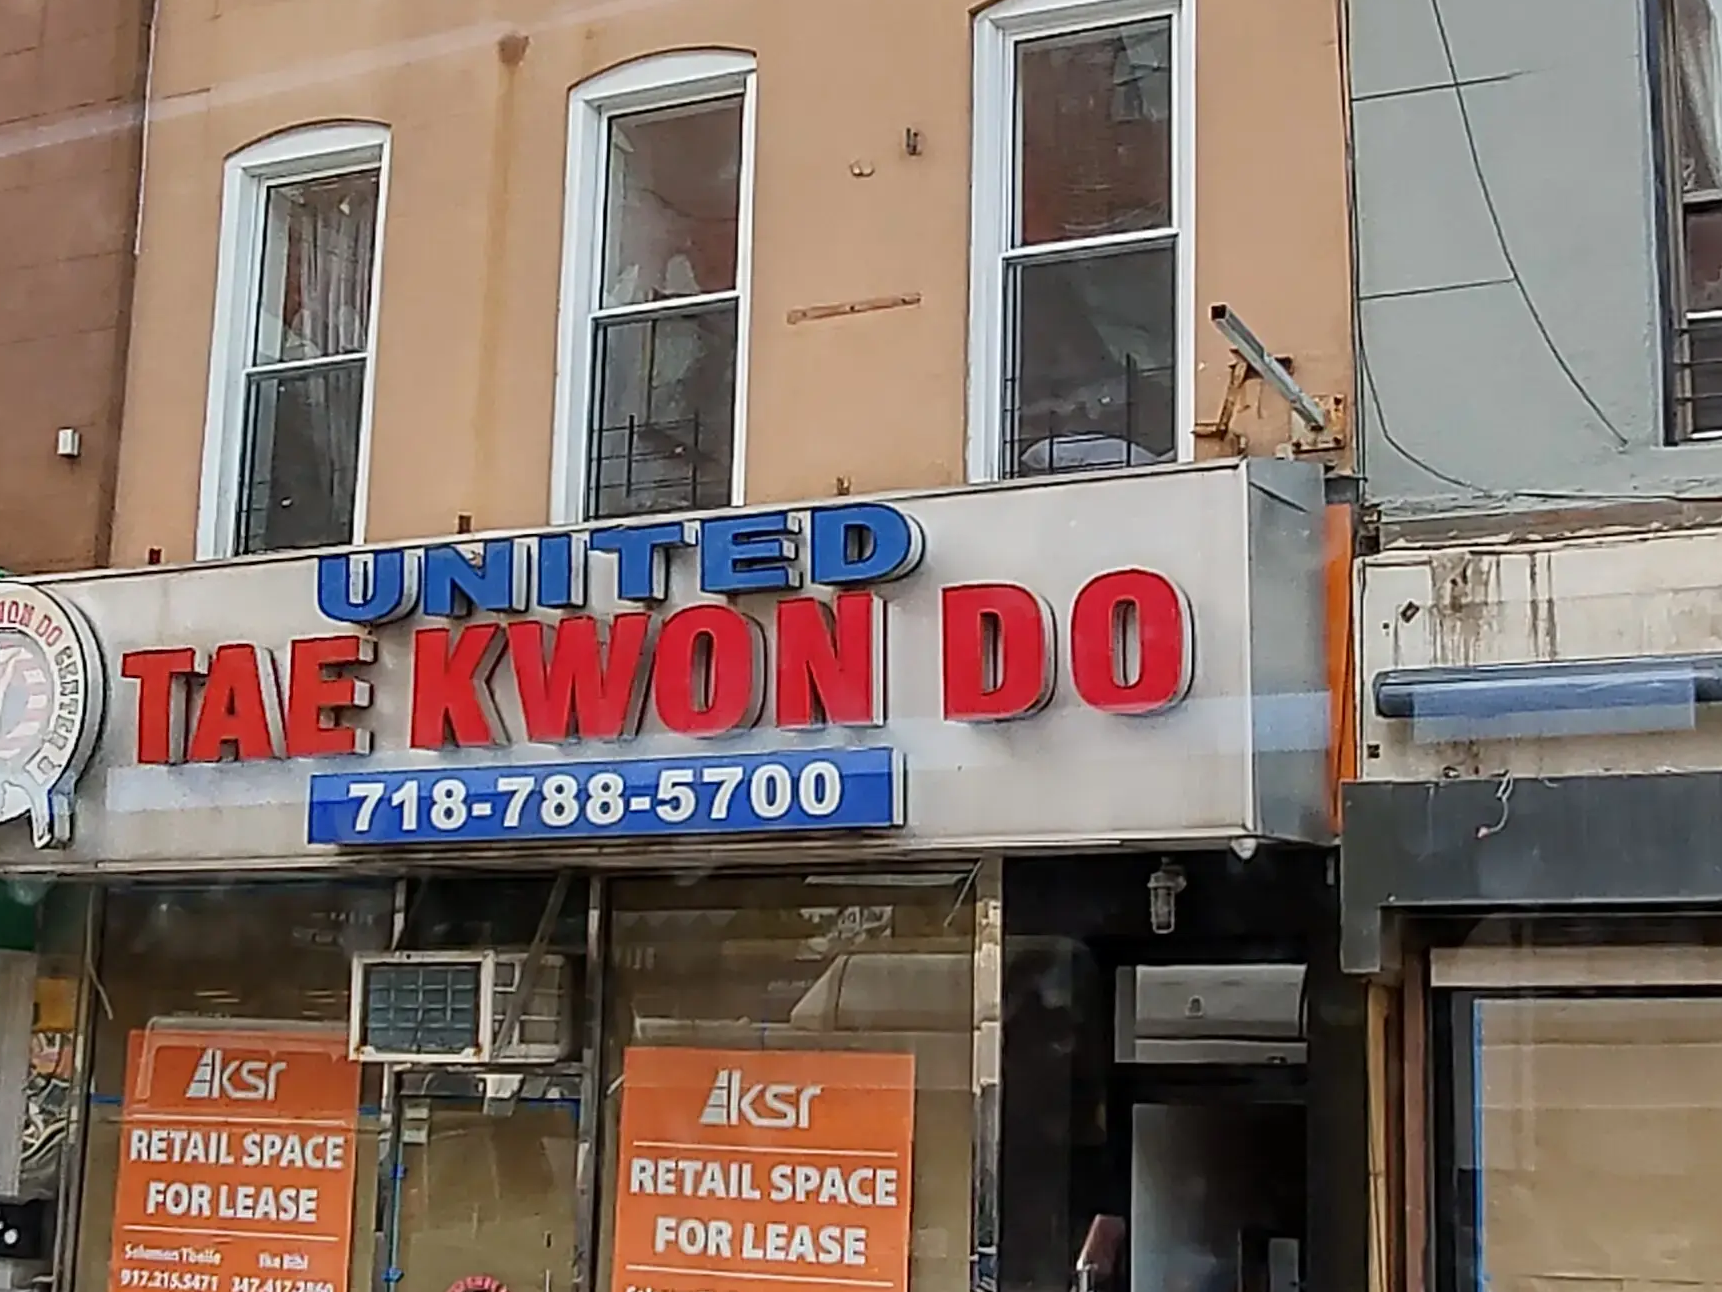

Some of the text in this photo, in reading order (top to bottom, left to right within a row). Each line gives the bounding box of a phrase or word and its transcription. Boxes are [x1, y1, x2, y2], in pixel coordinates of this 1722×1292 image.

[317, 503, 917, 622] UNITED
[35, 614, 65, 647] DO
[122, 567, 1189, 764] TAE KWON DO
[347, 760, 843, 833] 718-788-5700
[129, 1128, 345, 1170] RETAIL SPACE
[145, 1180, 318, 1223] FOR LEASE
[630, 1157, 898, 1207] RETAIL SPACE
[654, 1216, 867, 1266] FOR LEASE
